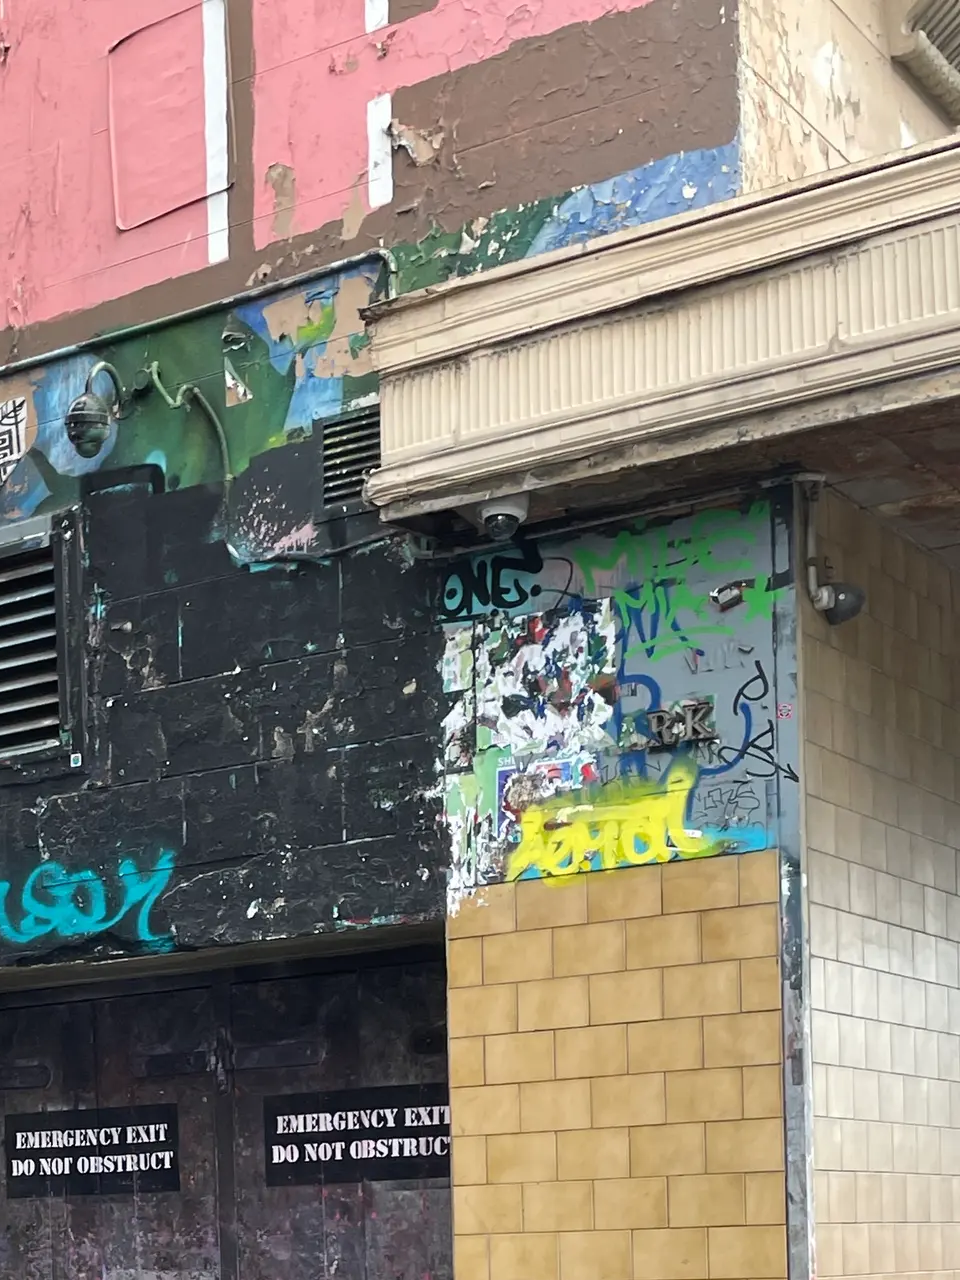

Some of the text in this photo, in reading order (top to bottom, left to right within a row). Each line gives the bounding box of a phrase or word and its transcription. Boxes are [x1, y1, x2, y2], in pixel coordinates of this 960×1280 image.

[276, 1105, 451, 1134] EMERGENCY EXIT
[15, 1123, 168, 1149] EMERGENCY EXIT
[11, 1151, 174, 1176] DO NOT OBSTRUCT
[271, 1136, 451, 1164] DO NOT OBSTRUC
